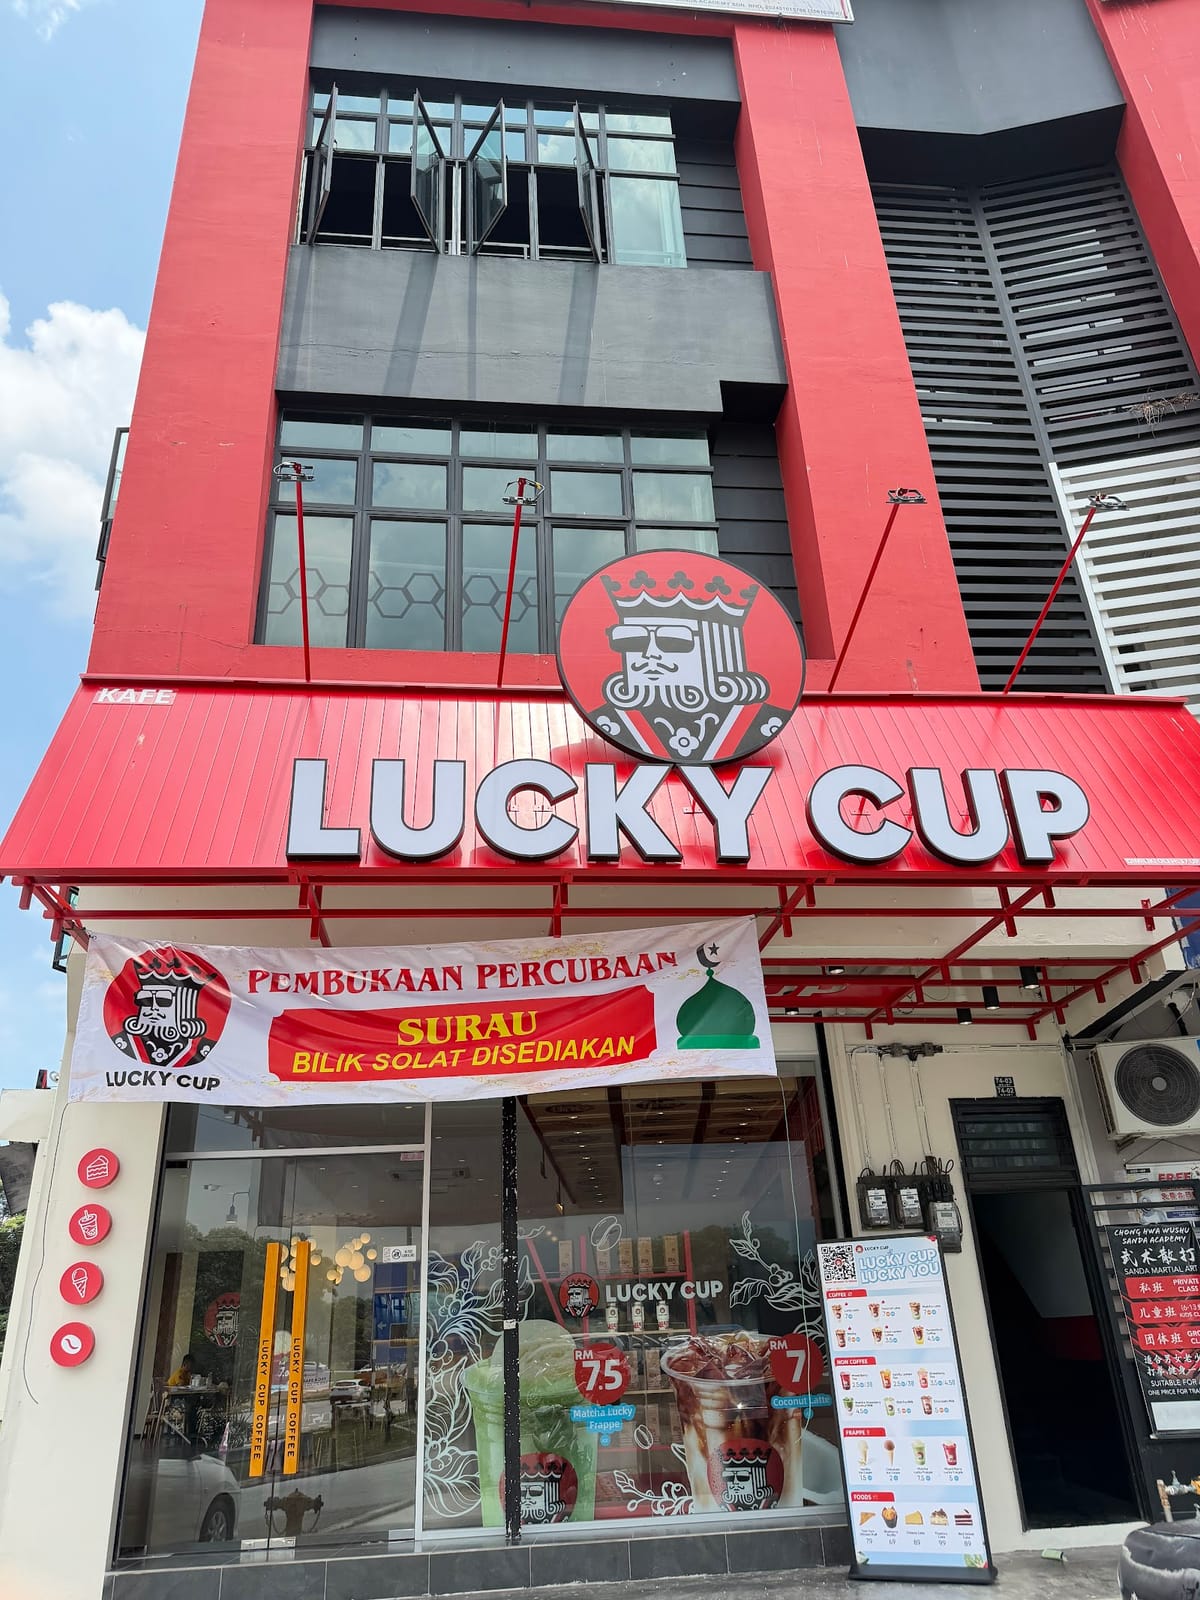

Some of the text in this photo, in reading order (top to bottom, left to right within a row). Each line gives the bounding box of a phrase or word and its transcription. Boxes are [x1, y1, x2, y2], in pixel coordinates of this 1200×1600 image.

[98, 688, 173, 704] KAFE
[286, 758, 1092, 866] LUCKY CUP
[248, 951, 679, 996] PEMBUKAAN PERCUBAAN
[397, 1011, 538, 1046] SURAU
[292, 1036, 635, 1073] BILIK SOLAT DISEDIAKAN
[106, 1071, 221, 1092] LUCKY CUP
[1114, 1226, 1190, 1236] CHONG HWA WUSHU
[1122, 1235, 1187, 1245] SANDA ACADEMY
[859, 1249, 937, 1270] LUCKY CUP
[1120, 1245, 1196, 1267] 武术散打
[860, 1262, 940, 1284] LUCKY YOU
[1124, 1264, 1198, 1275] SANDA MARTIAL ART
[605, 1280, 724, 1302] LUCKY CUP
[1139, 1282, 1165, 1294] 私班
[1139, 1305, 1177, 1319] 儿童班
[770, 1339, 788, 1350] RM
[1144, 1332, 1183, 1346] 团体班
[575, 1350, 593, 1360] RM
[582, 1359, 623, 1391] 7.5
[786, 1349, 806, 1383] 7
[1150, 1378, 1197, 1387] SUITABLE FOR
[253, 1339, 269, 1460] LUCKY CUP COFFEE
[287, 1337, 301, 1457] LUCKY CUP COFFEE
[773, 1395, 830, 1406] Coconut atte
[573, 1406, 633, 1418] Matcha Lucky
[590, 1420, 620, 1431] Frappe
